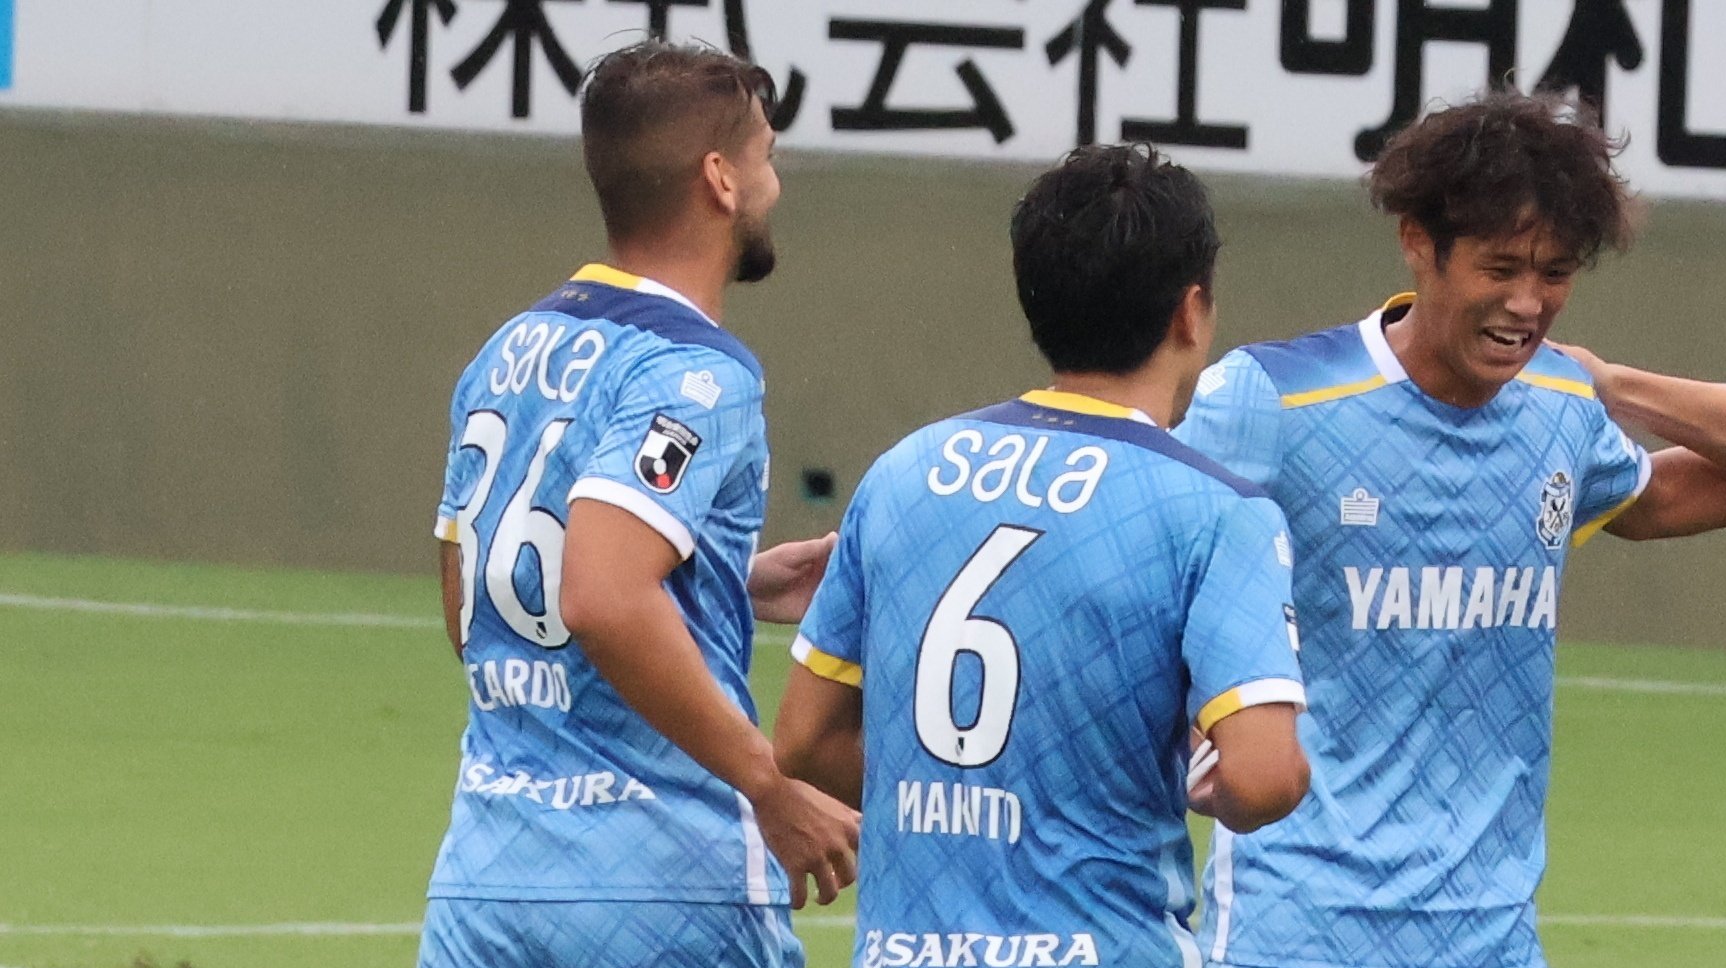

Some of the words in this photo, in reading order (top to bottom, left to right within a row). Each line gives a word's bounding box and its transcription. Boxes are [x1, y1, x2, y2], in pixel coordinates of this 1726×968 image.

[927, 429, 1108, 514] sala
[1343, 565, 1556, 630] YAMAHA
[912, 522, 1047, 770] 6
[884, 932, 1099, 968] SAKURA
